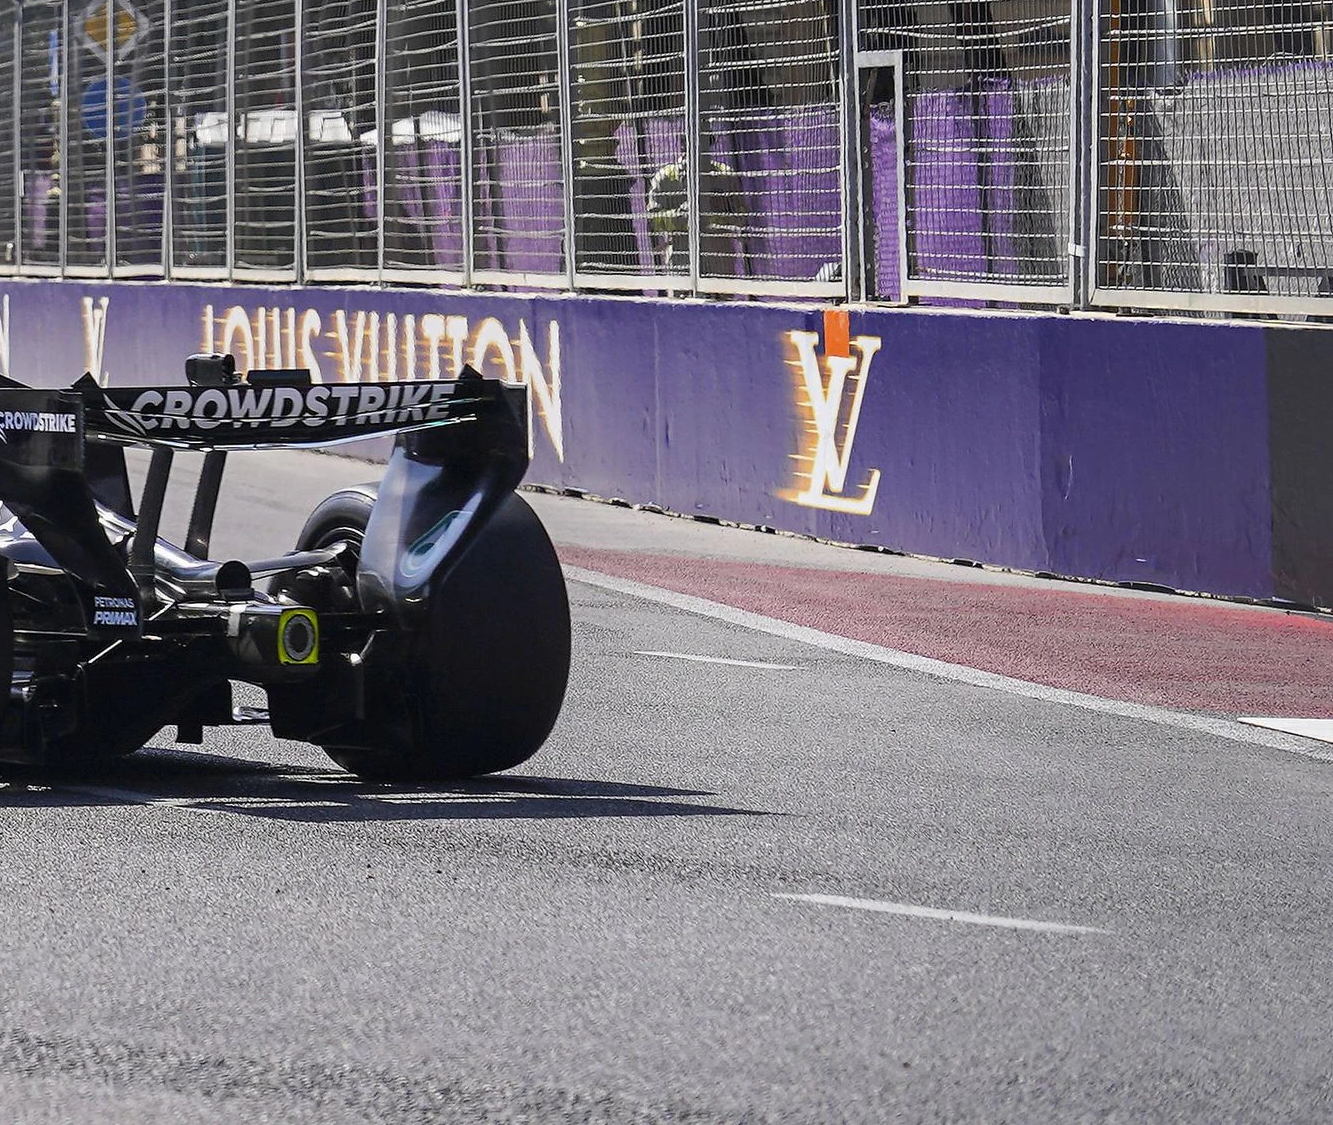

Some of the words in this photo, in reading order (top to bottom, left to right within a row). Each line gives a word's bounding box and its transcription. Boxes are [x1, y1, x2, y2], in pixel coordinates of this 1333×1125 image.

[335, 309, 564, 464] VUITTON
[132, 383, 456, 431] CROWDSTRIKE
[94, 596, 135, 608] PETRONAS
[94, 611, 137, 626] PRIMAX
